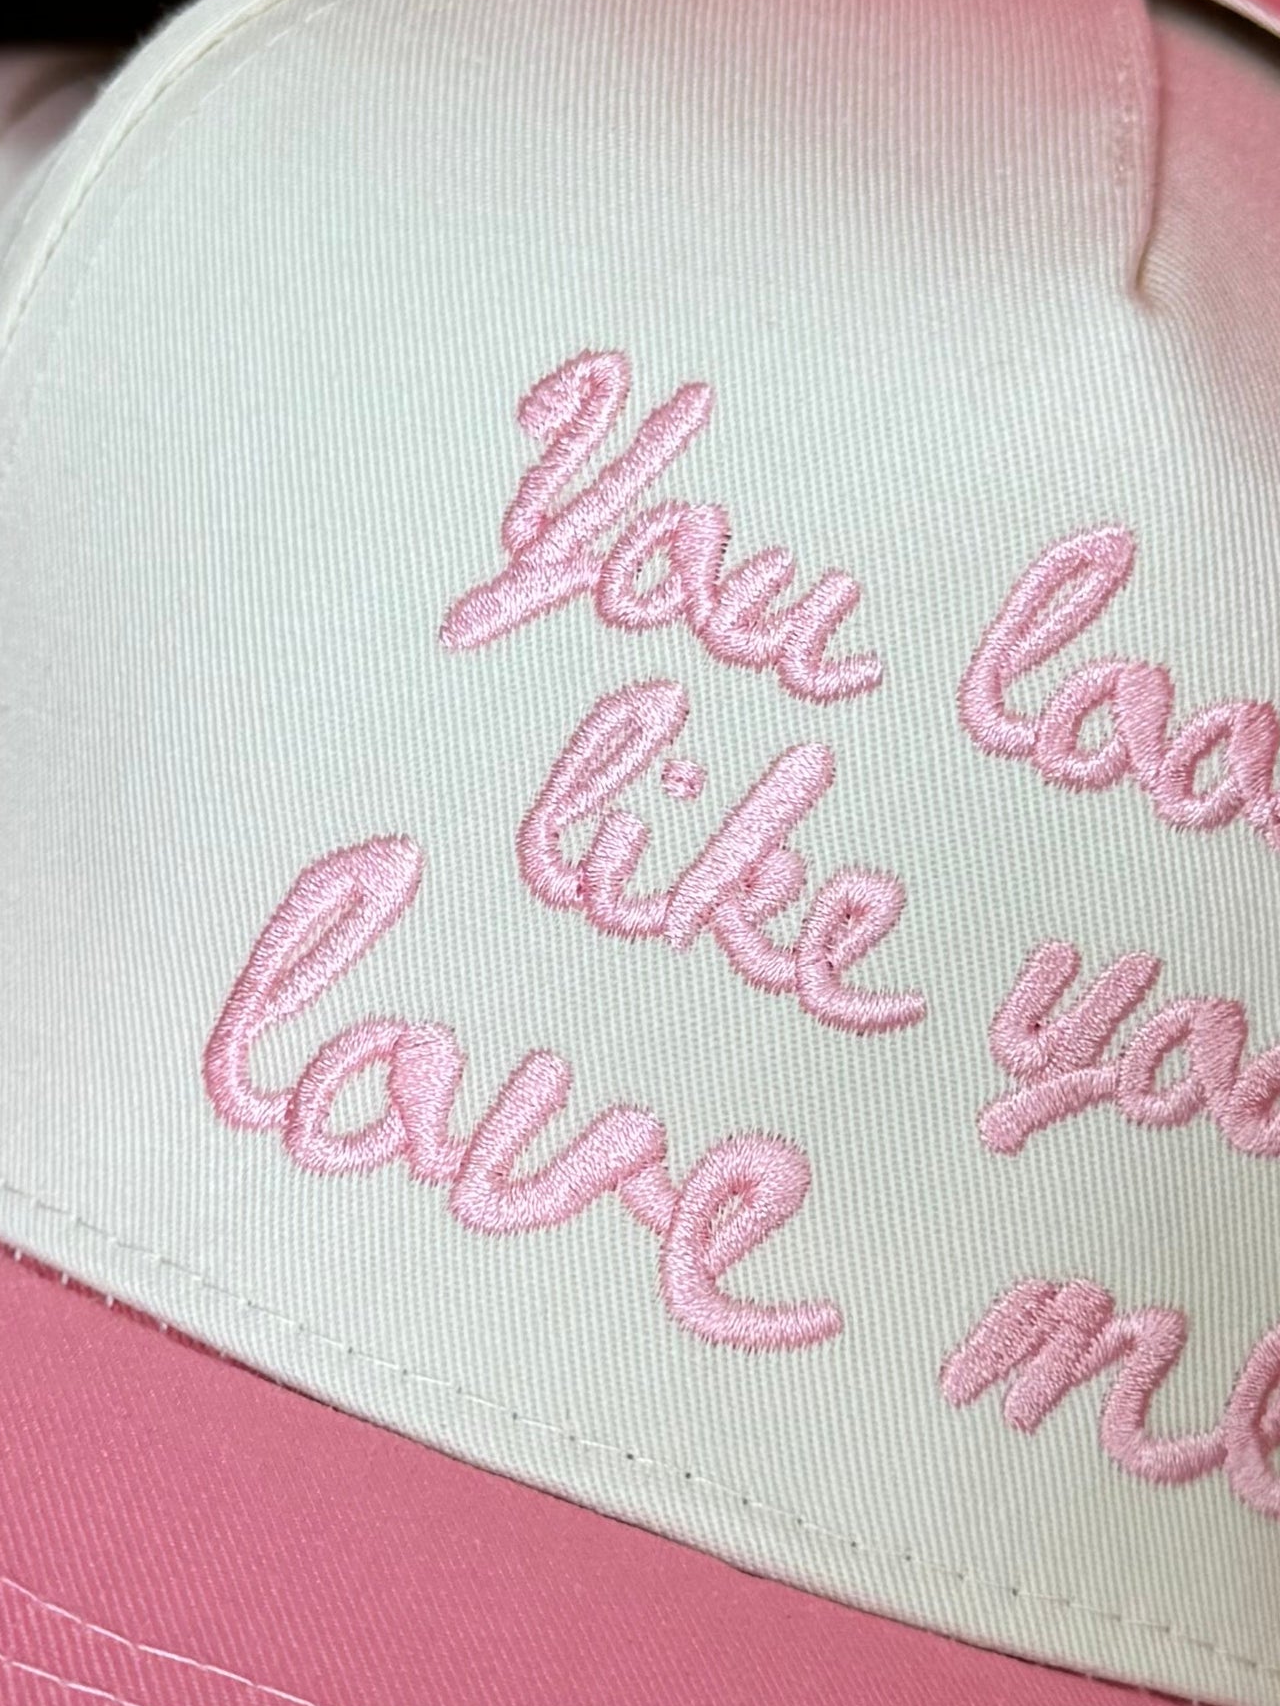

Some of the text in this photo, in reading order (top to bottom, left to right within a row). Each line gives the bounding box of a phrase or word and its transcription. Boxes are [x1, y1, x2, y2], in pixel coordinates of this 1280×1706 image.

[439, 348, 882, 703] You
[517, 678, 927, 1034] like
[204, 834, 842, 1352] love
